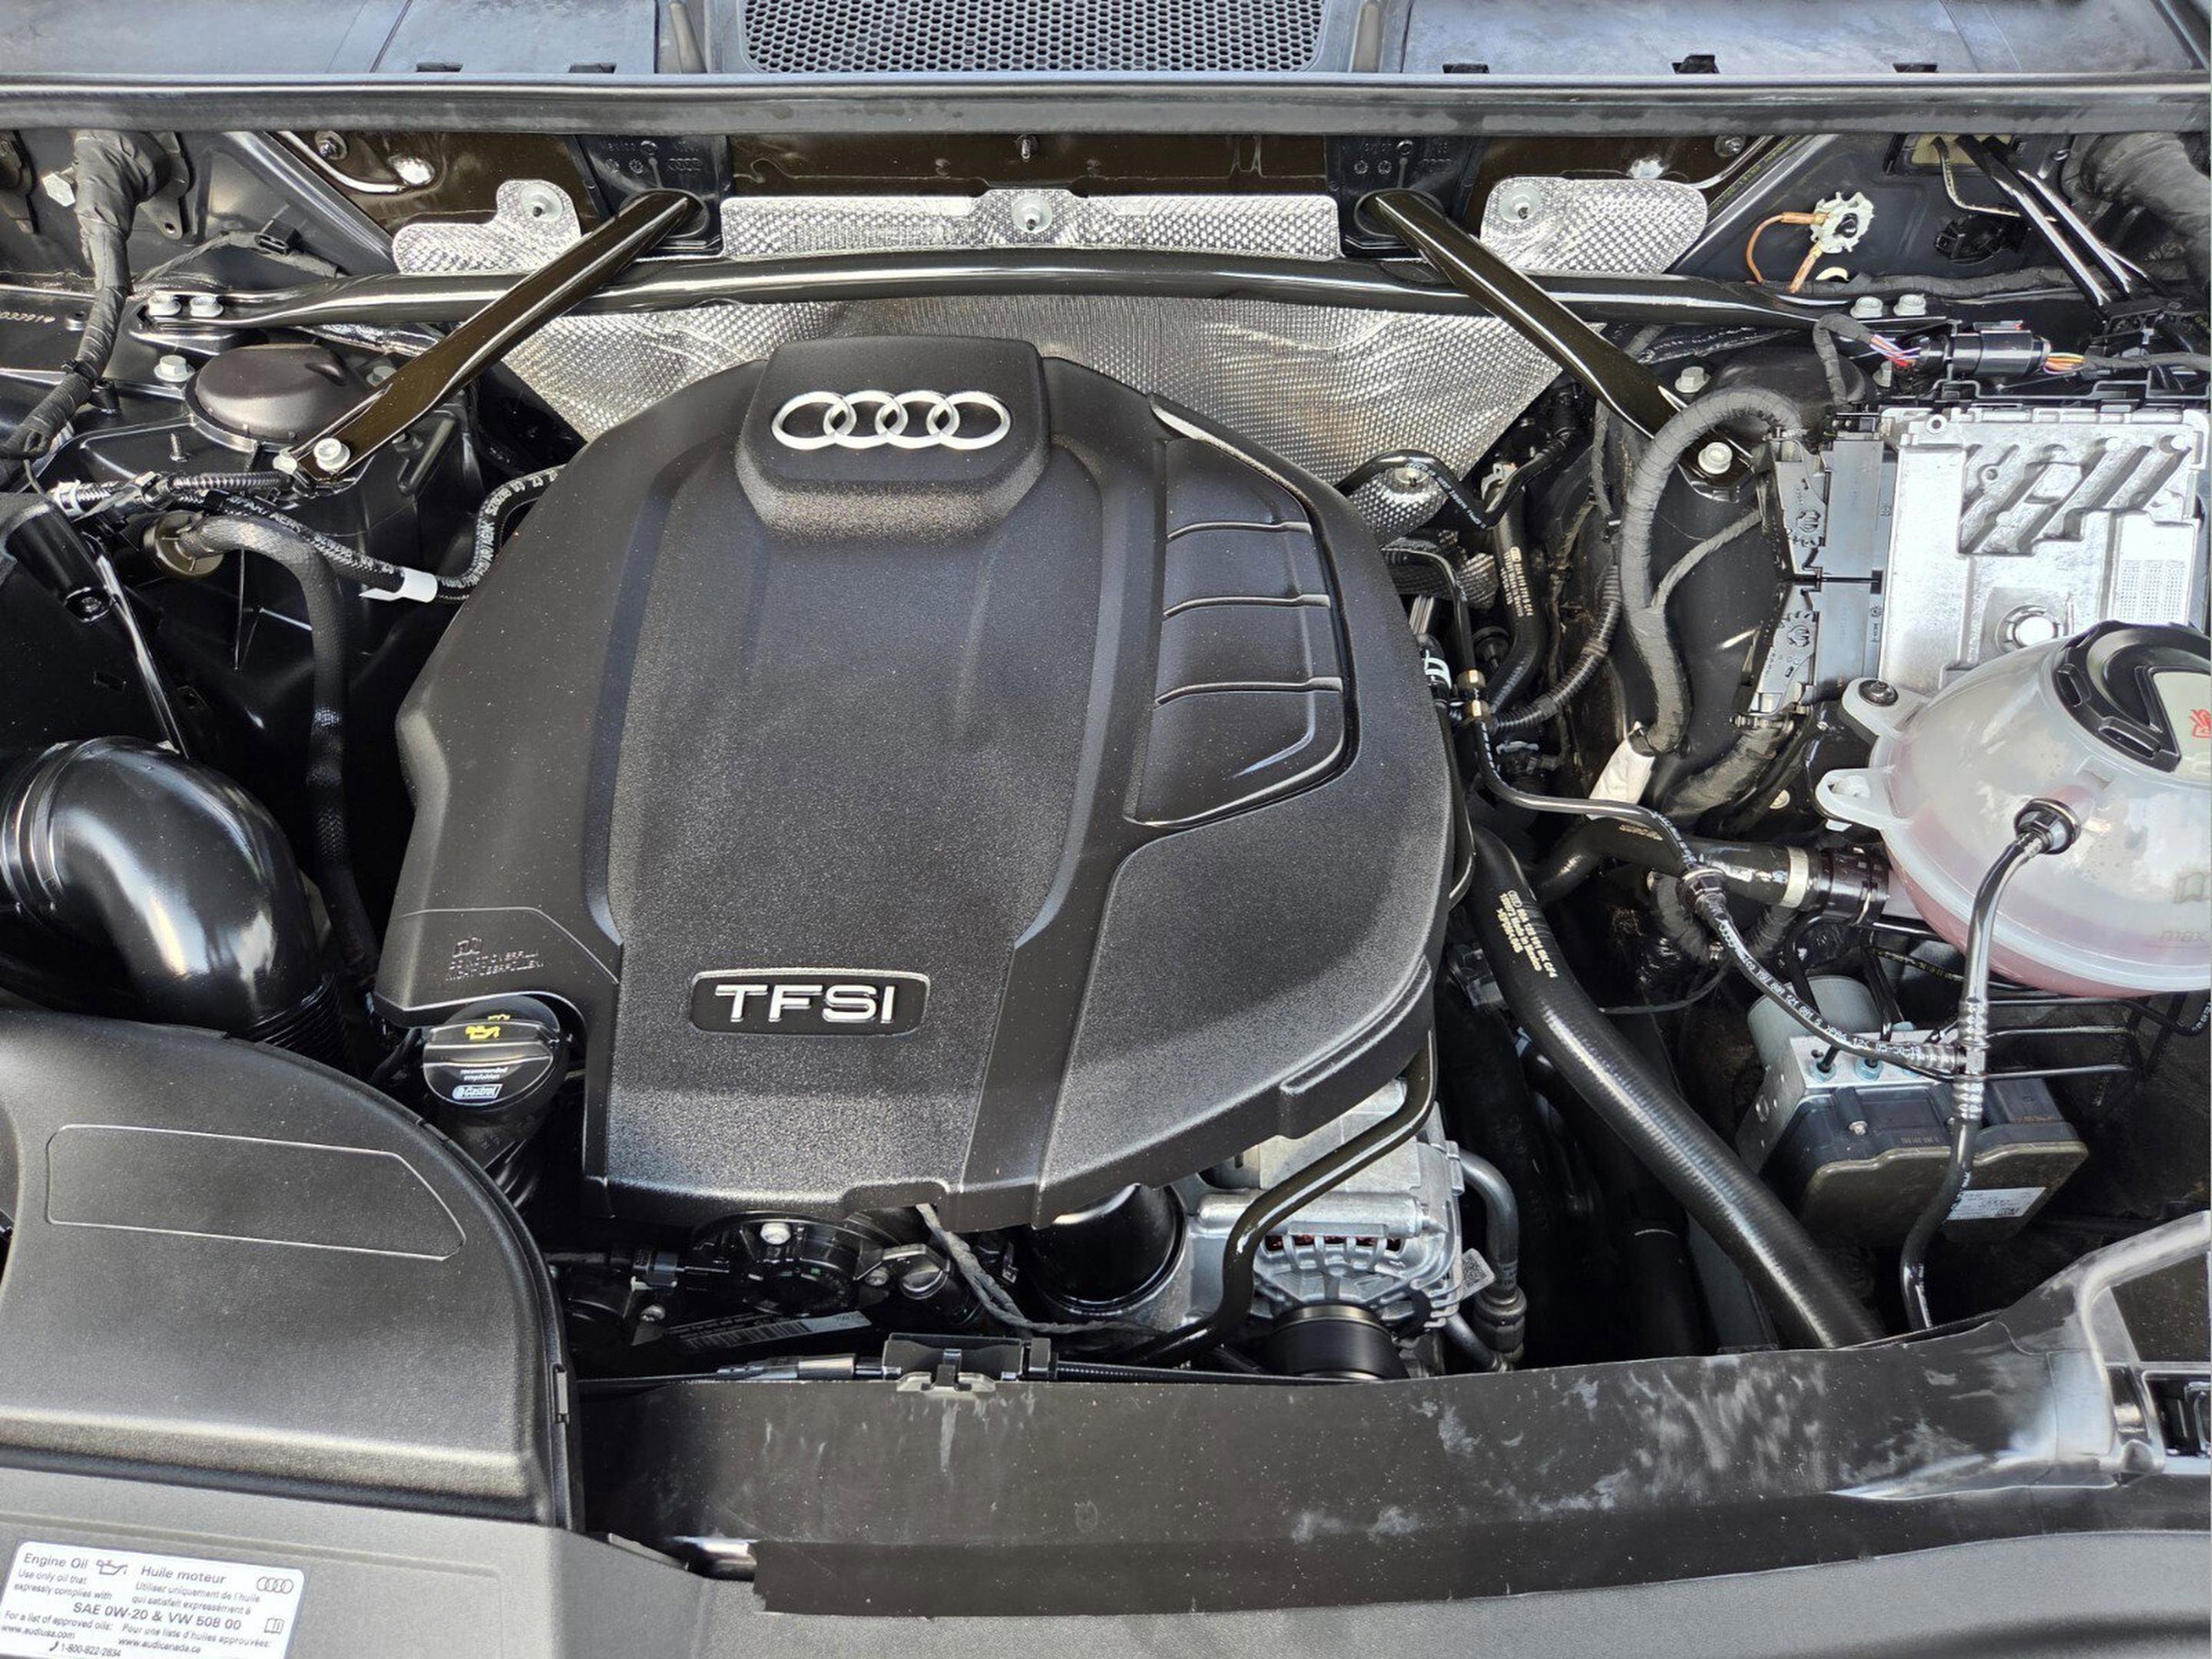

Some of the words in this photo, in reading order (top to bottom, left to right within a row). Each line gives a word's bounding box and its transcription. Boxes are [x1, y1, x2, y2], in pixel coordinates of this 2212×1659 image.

[714, 984, 896, 1024] TFSI
[463, 1084, 496, 1098] Castrol
[23, 1553, 67, 1568] Engine
[71, 1558, 89, 1569] Oil
[18, 1568, 33, 1579] Use
[36, 1571, 55, 1583] only
[57, 1574, 68, 1583] oil
[70, 1575, 88, 1585] that
[141, 1565, 174, 1579] Huile
[176, 1571, 227, 1584] moteur
[14, 1583, 54, 1595] expressly
[54, 1587, 92, 1598] complies
[94, 1591, 112, 1601] with
[135, 1581, 167, 1593] Utilisez
[167, 1585, 220, 1599] uniquement
[221, 1591, 232, 1600] de
[131, 1594, 147, 1604] qui
[147, 1597, 182, 1608] satisfait
[245, 1606, 252, 1616] à
[5, 1610, 18, 1620] For
[27, 1613, 41, 1623] list
[41, 1615, 52, 1624] of
[52, 1618, 94, 1629] approved
[94, 1621, 114, 1631] oils:
[73, 1602, 101, 1615] SAE
[104, 1605, 149, 1621] 0W-20
[151, 1611, 164, 1622] &
[168, 1611, 194, 1625] VW
[195, 1616, 221, 1628] 508
[224, 1618, 243, 1631] 00
[1, 1624, 76, 1640] www.audiusa.com
[121, 1623, 144, 1634] Pour
[144, 1627, 161, 1636] une
[162, 1628, 180, 1639] liste
[61, 1643, 122, 1657] 1-800-822-2834
[118, 1637, 202, 1654] www.audicanada.ca
